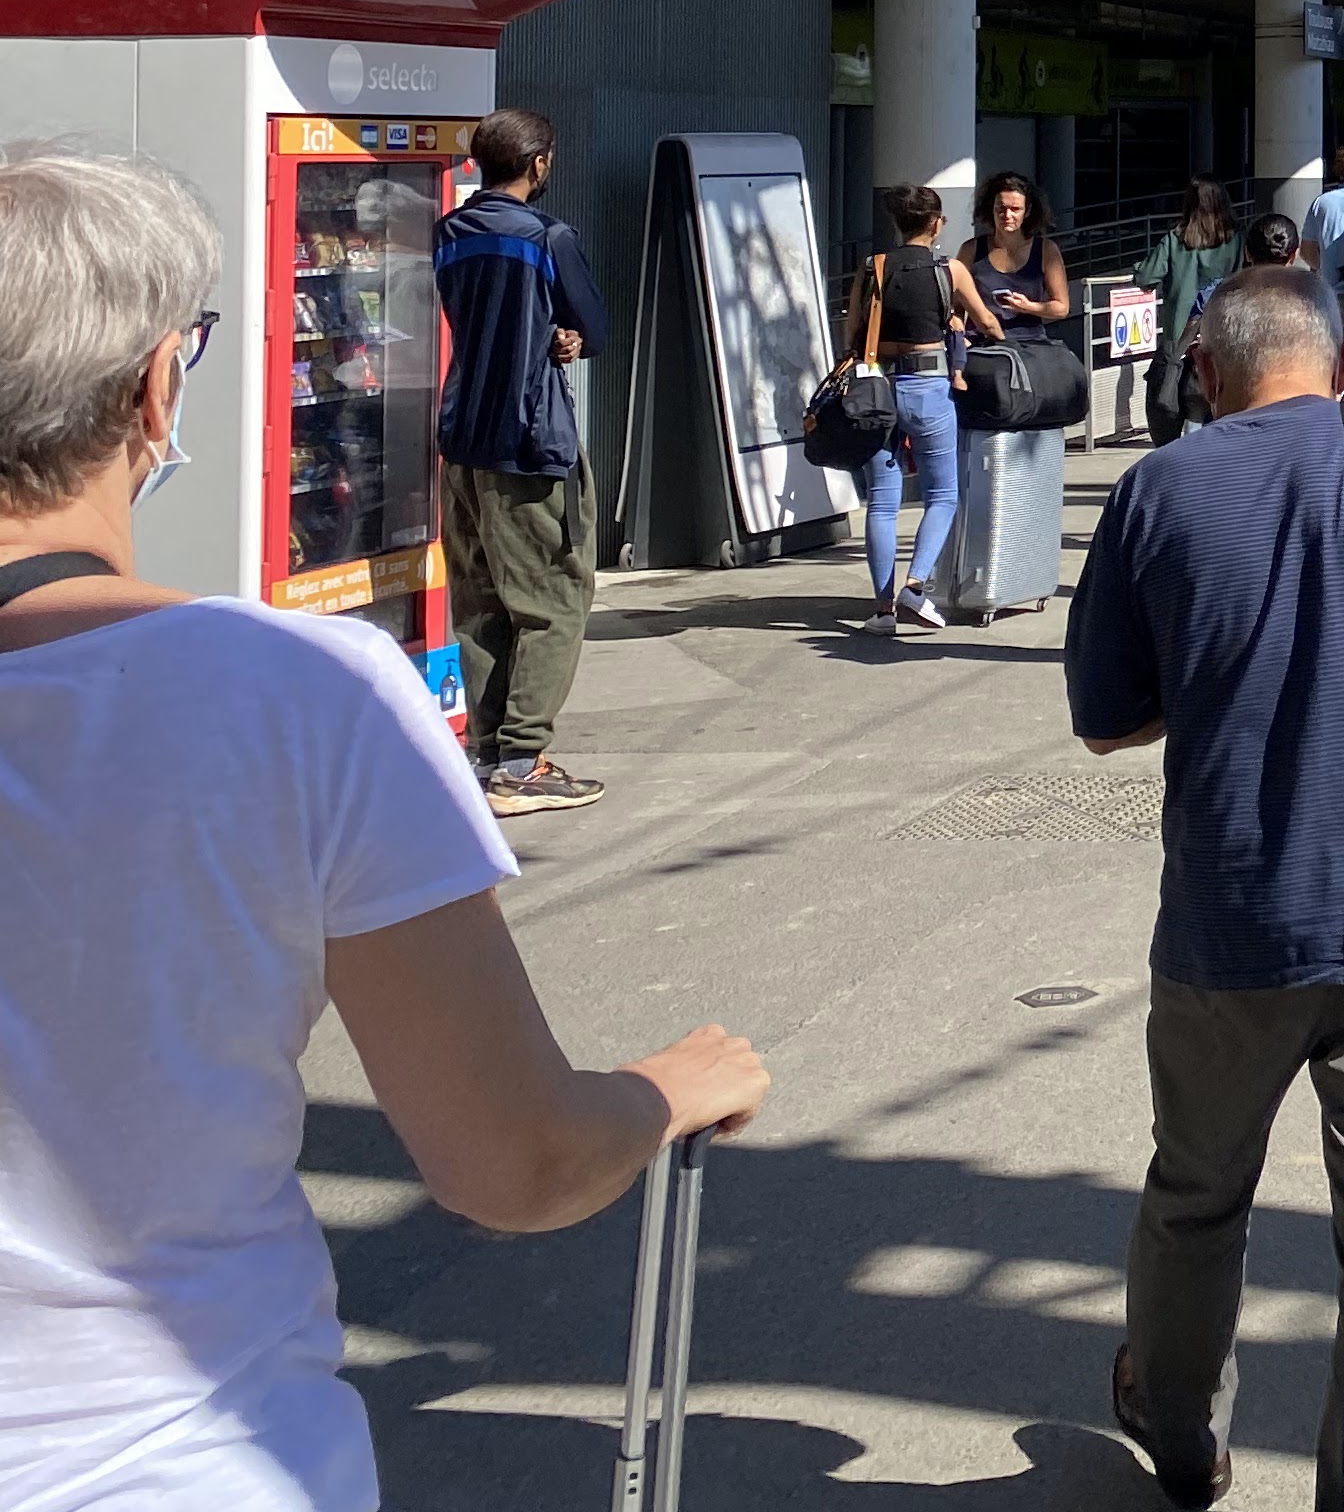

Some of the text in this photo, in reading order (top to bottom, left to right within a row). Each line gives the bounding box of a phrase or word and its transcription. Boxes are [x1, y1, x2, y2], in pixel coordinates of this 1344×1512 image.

[368, 62, 438, 92] selecta
[302, 122, 335, 152] Ici!
[389, 128, 408, 140] VISA
